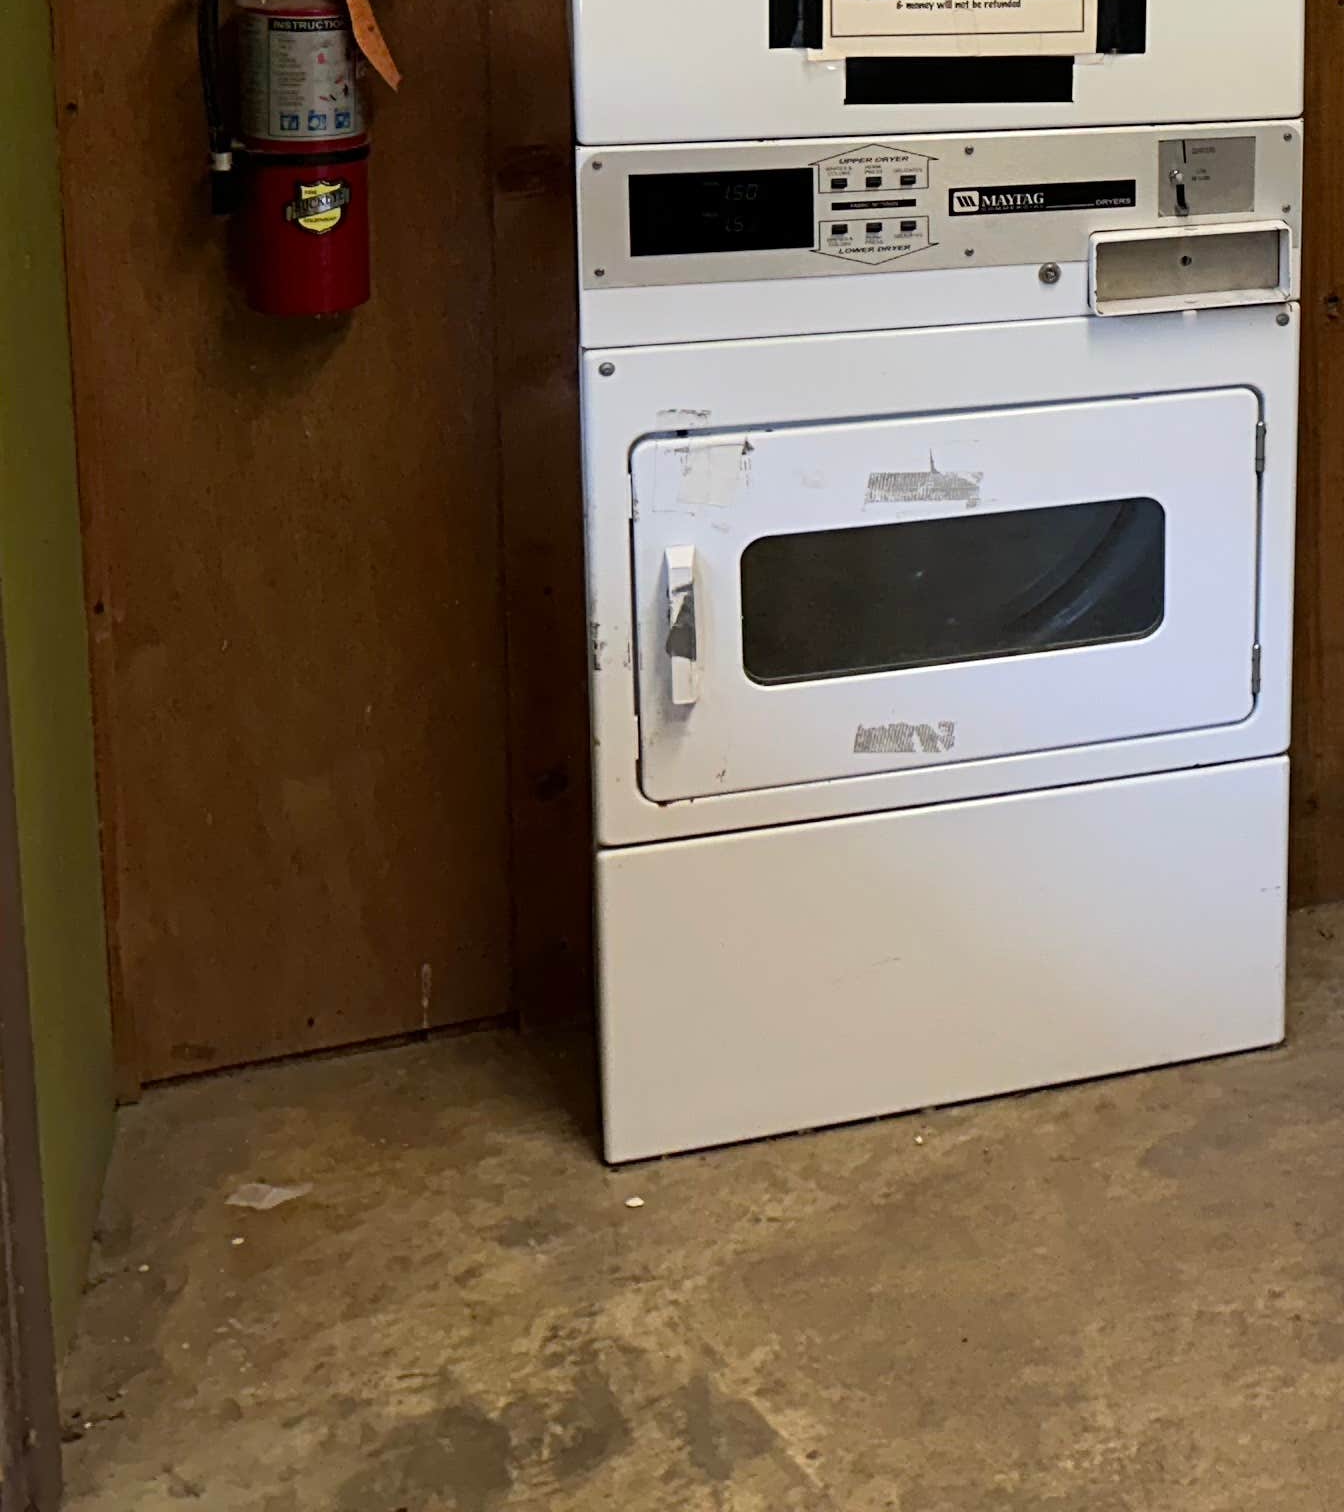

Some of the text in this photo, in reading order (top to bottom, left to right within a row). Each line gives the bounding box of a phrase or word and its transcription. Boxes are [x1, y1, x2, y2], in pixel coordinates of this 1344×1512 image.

[906, 2, 934, 10] money
[937, 0, 952, 8] will
[955, 0, 969, 8] not
[972, 0, 981, 8] be
[984, 0, 1021, 8] refunded
[839, 157, 872, 165] UPPER
[982, 192, 1044, 208] MAYTAG
[839, 245, 911, 254] LOWER DRYER
